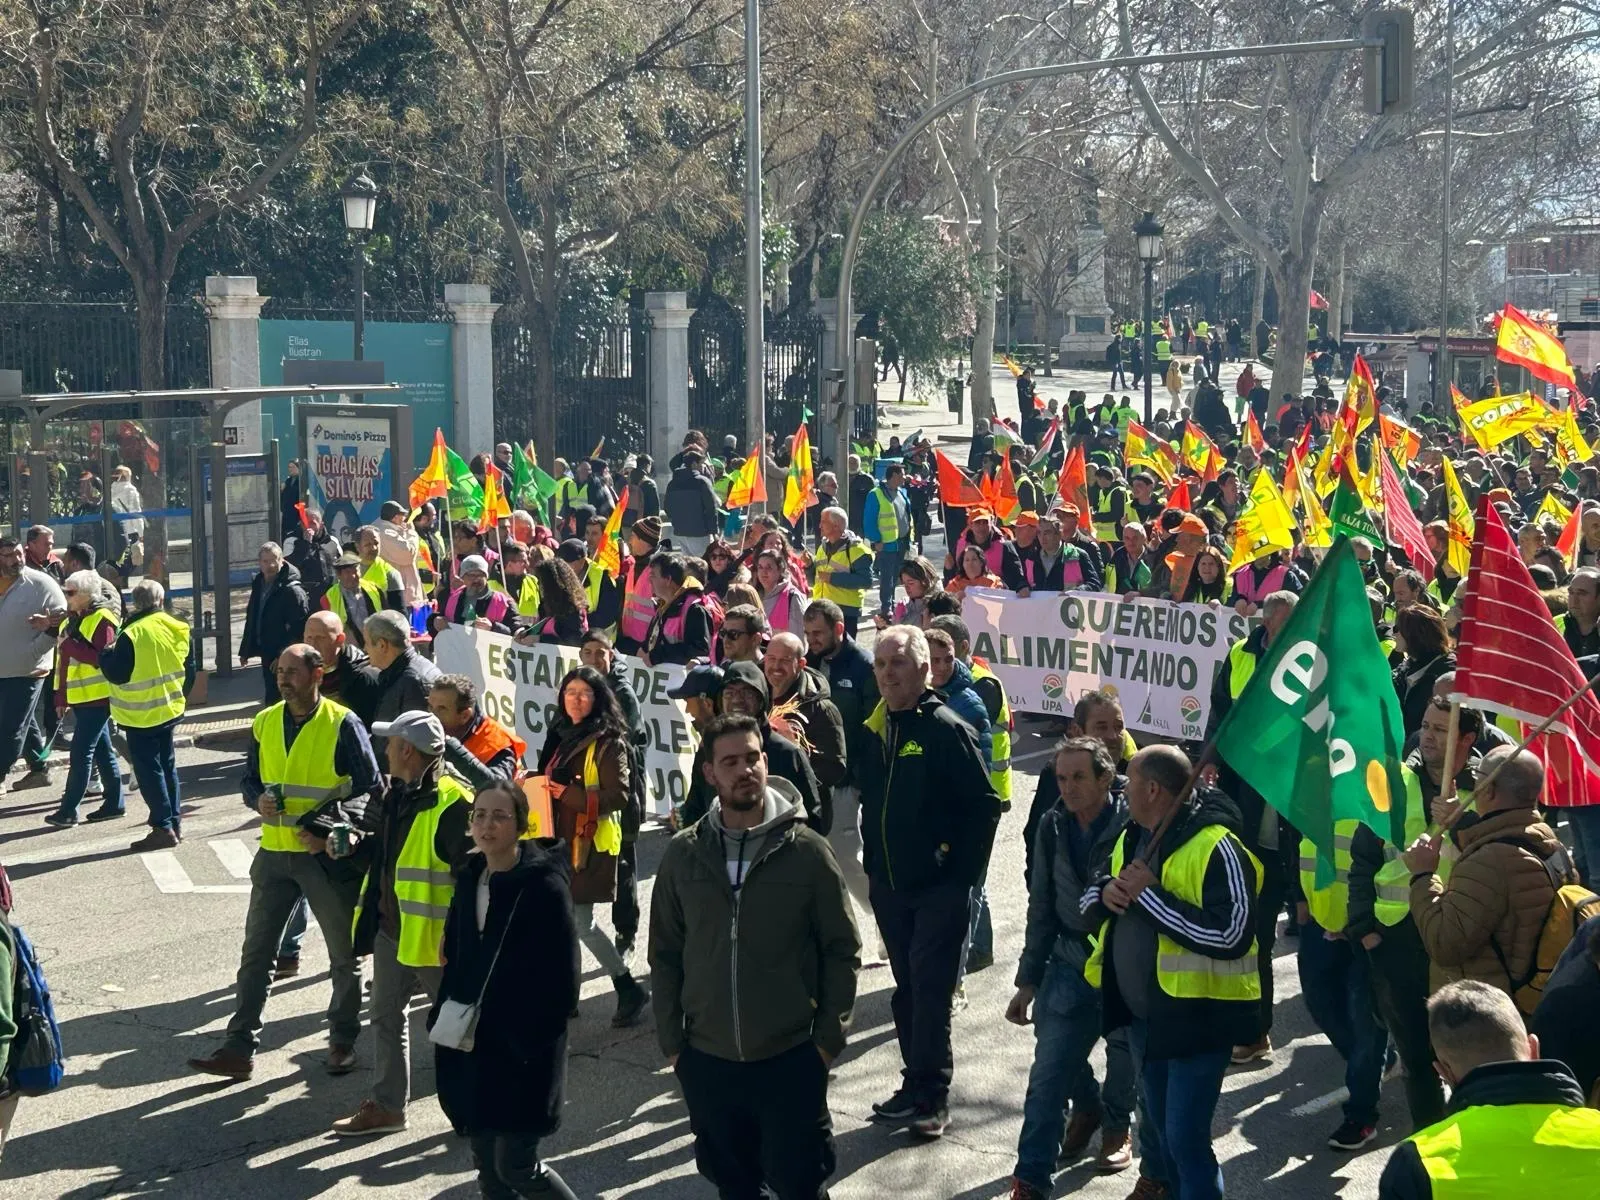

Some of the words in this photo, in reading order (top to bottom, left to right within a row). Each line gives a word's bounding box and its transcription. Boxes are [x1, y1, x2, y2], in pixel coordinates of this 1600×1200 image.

[323, 430, 362, 441] Domino's
[363, 431, 387, 442] Pizza
[1060, 597, 1217, 648] QUEREMOS
[971, 631, 1198, 691] ALIMENTANDO
[632, 668, 670, 706] DE
[1041, 699, 1063, 713] UPA
[1180, 723, 1203, 738] UPA
